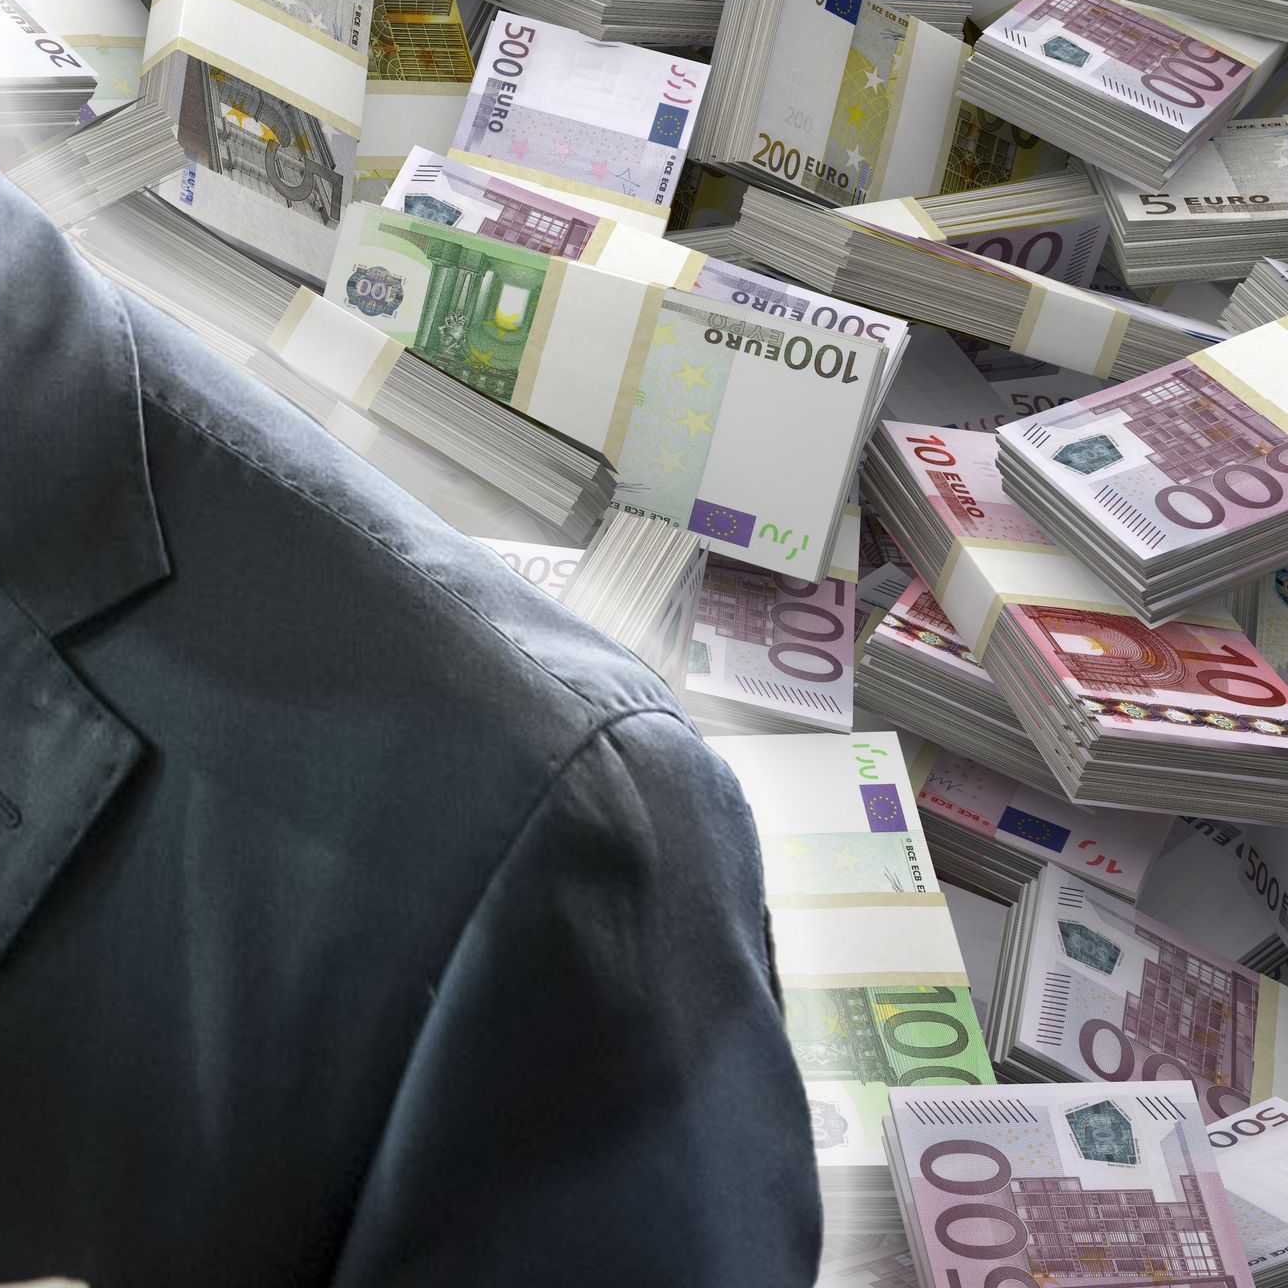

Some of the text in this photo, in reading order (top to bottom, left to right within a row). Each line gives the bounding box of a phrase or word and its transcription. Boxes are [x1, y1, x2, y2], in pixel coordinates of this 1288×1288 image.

[871, 3, 909, 27] BCE ECB EZB
[35, 38, 81, 70] 20
[488, 22, 536, 133] 500 EURO
[752, 133, 849, 188] 200 EURO
[1138, 193, 1270, 215] 5 EURO
[704, 326, 859, 385] 100 EURO
[907, 433, 985, 520] 10 EURO
[1196, 643, 1287, 708] 10
